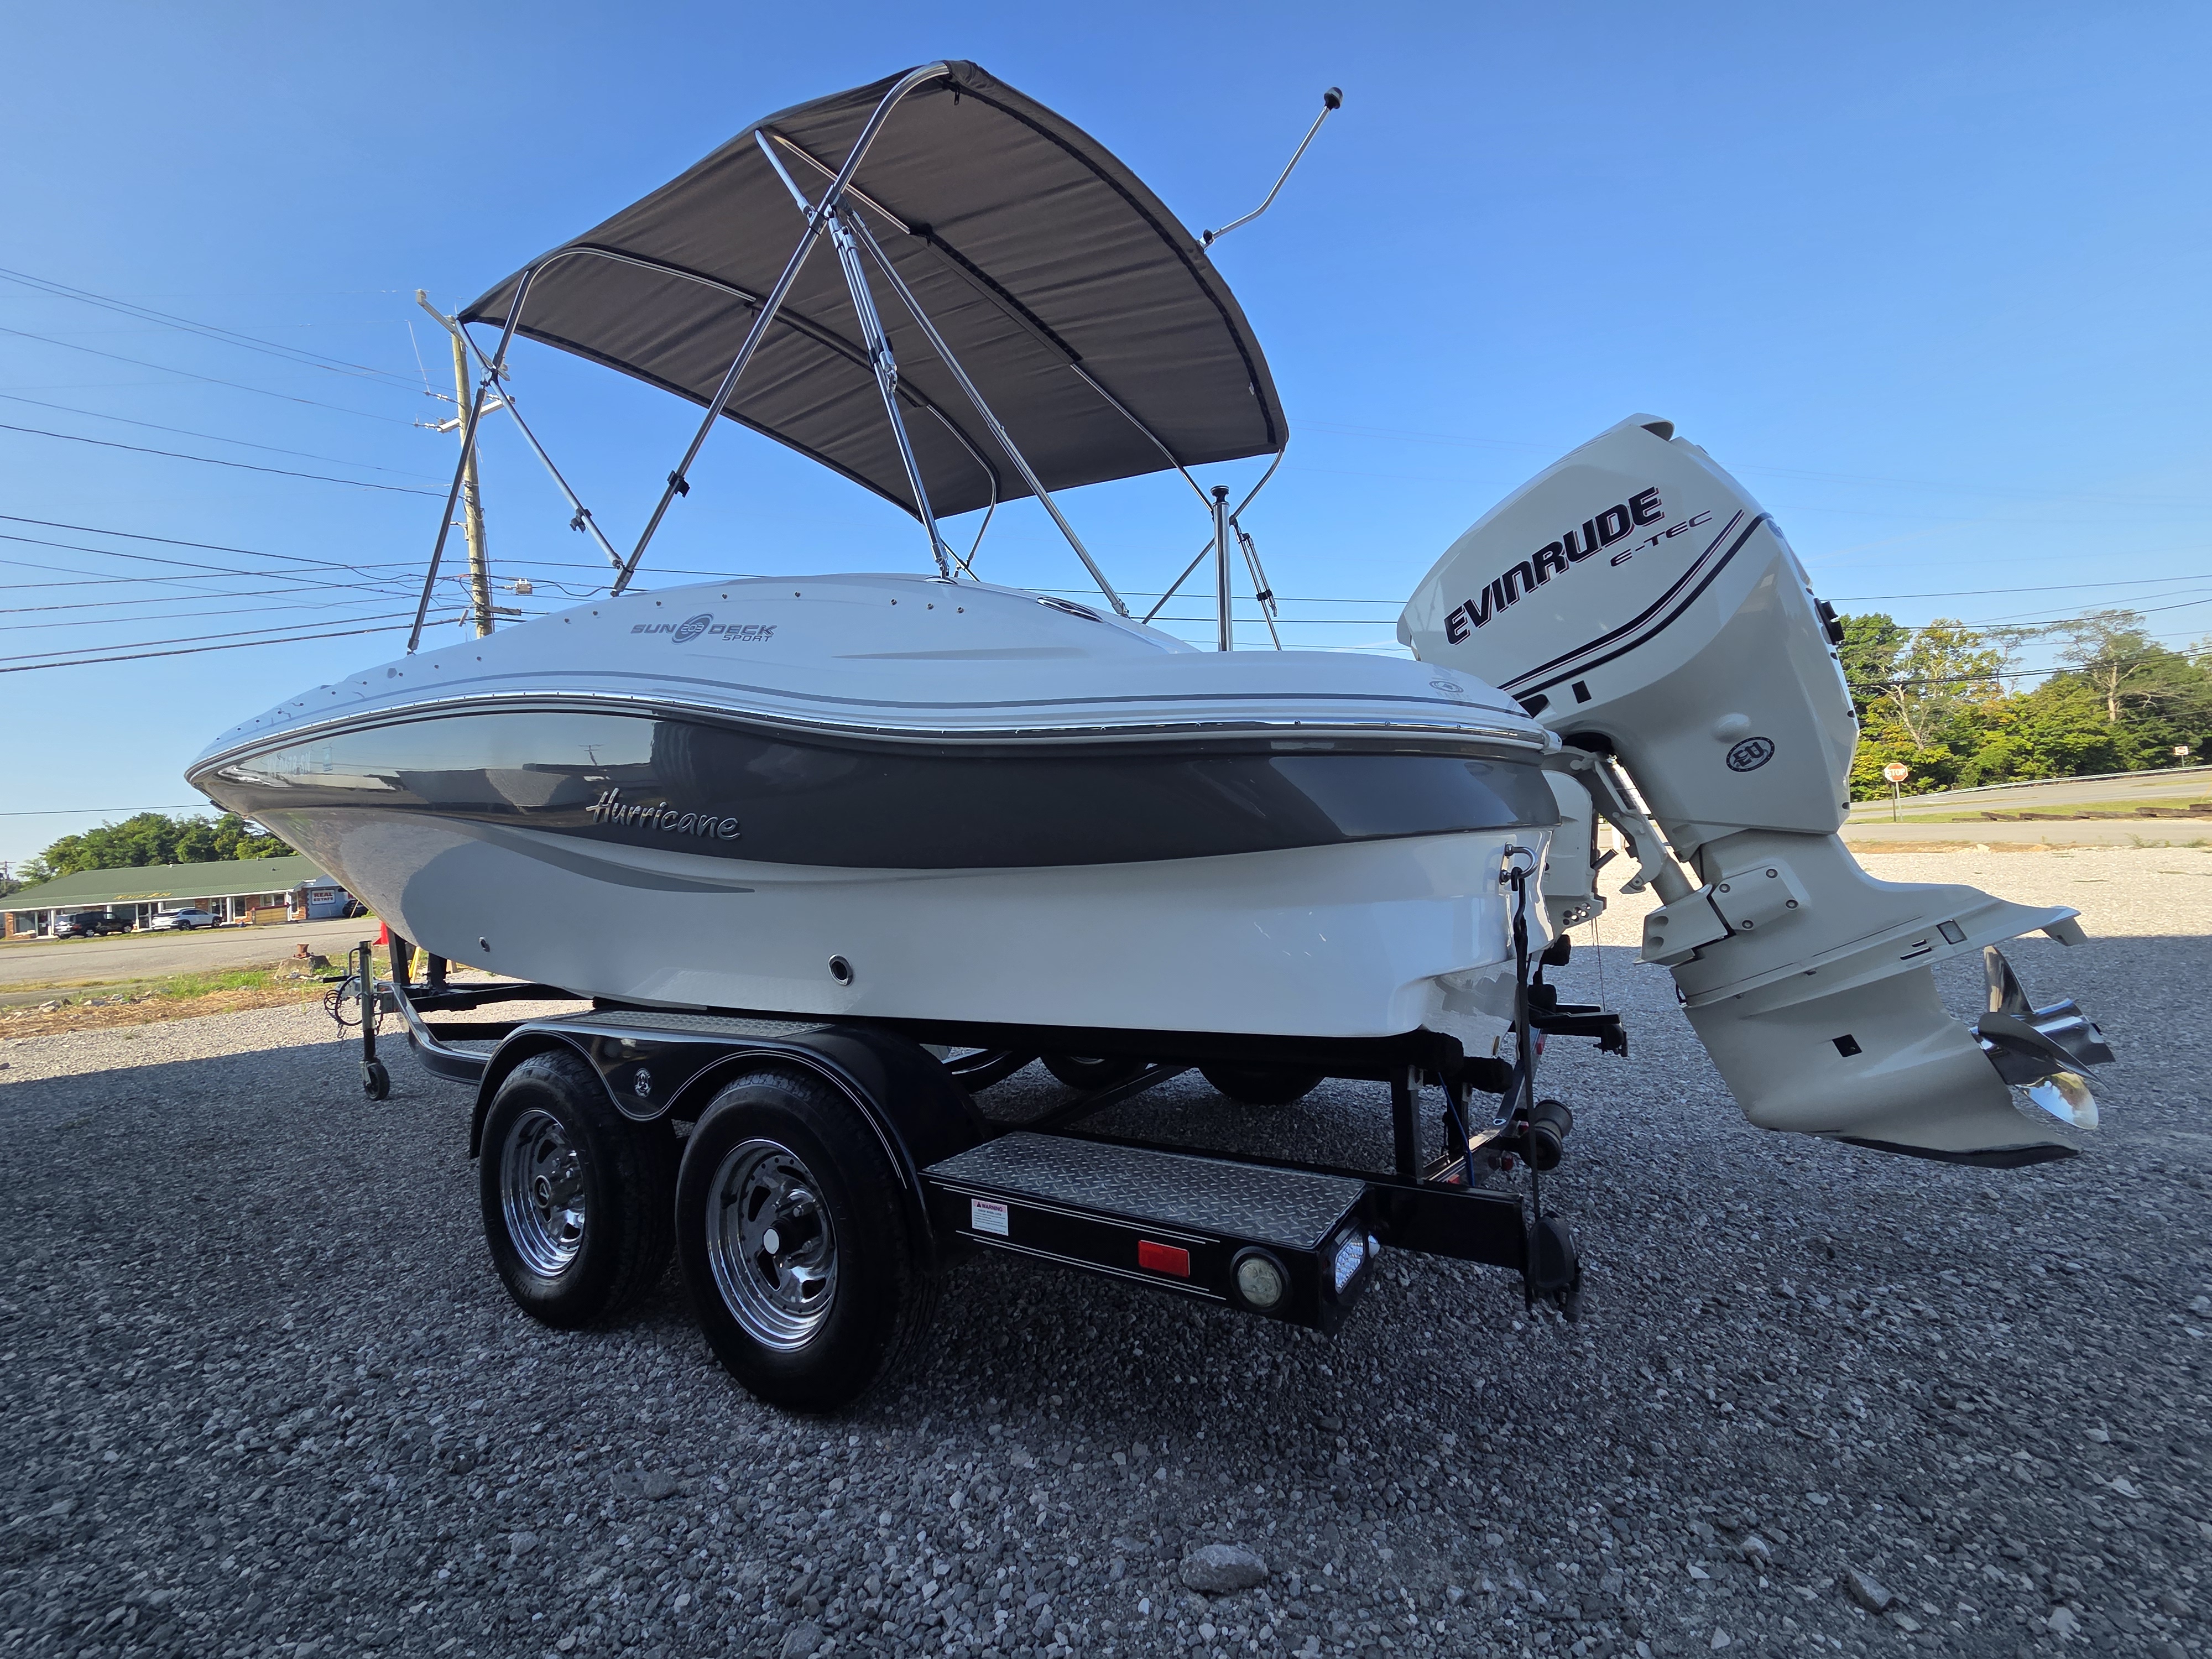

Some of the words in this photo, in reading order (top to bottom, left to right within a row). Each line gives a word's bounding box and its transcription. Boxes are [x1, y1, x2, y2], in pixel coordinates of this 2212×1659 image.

[1610, 510, 1713, 567] E-TEC
[1443, 487, 1665, 645] EVINRUDE
[630, 624, 677, 634] SUN
[680, 623, 705, 633] 203
[707, 624, 778, 636] DECK
[722, 634, 773, 643] SPORT
[1887, 768, 1906, 776] STOP
[586, 787, 740, 840] Hurricane
[982, 1203, 1003, 1212] WARNING
